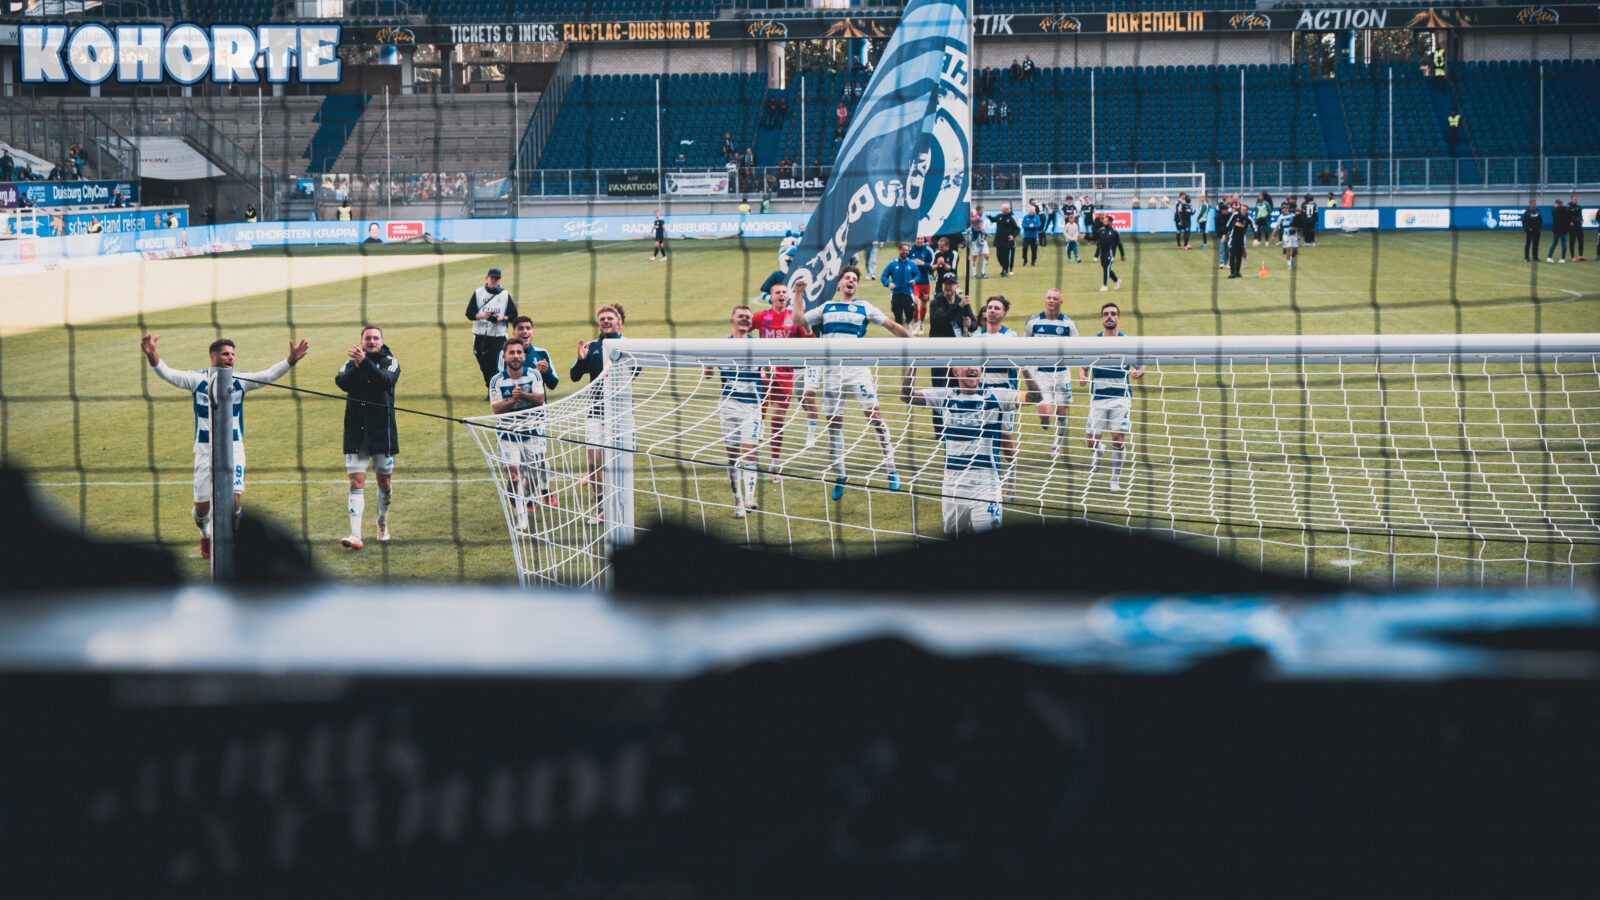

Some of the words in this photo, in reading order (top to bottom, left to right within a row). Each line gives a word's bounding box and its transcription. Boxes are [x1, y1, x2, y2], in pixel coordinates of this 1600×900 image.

[1107, 12, 1204, 32] ADRENALIN
[1296, 9, 1387, 29] ACTION
[451, 25, 500, 43] TICKETS
[505, 26, 514, 42] &
[519, 24, 559, 42] INFOS:
[563, 21, 711, 41] FLICFLAC-DUISBURG.DE
[608, 183, 658, 192] FANATICOS
[779, 177, 825, 190] Block
[52, 185, 82, 202] Duisburg
[82, 184, 109, 202] CityCom
[122, 213, 146, 232] reisen
[719, 222, 738, 232] AM
[741, 221, 792, 232] MORGEN
[255, 229, 311, 240] THORSTEN
[313, 228, 359, 239] KRAPPA
[765, 330, 791, 339] MSV
[235, 465, 242, 478] 9
